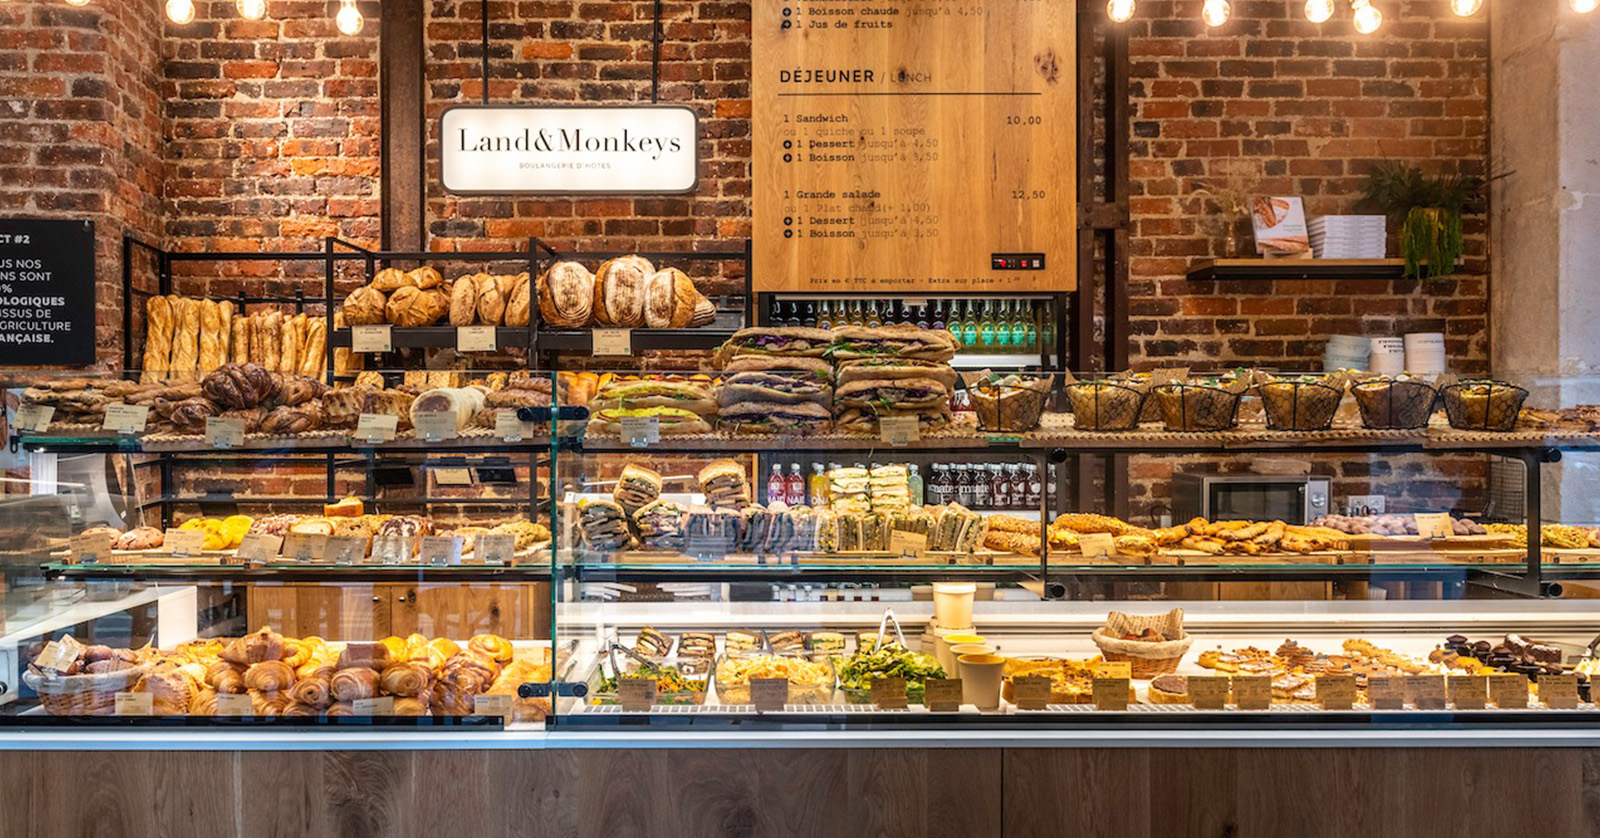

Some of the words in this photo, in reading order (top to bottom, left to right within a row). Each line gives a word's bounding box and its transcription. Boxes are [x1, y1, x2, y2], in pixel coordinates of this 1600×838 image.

[808, 7, 854, 15] Boisson
[860, 7, 899, 15] chaude
[809, 20, 828, 28] Jus
[835, 20, 847, 28] de
[854, 20, 892, 28] fruits
[780, 67, 874, 82] DÉJEUNER
[890, 72, 931, 83] LUNCH
[784, 114, 789, 123] 1
[796, 114, 848, 123] Sandwich
[816, 127, 855, 137] quiche
[860, 128, 874, 136] ou
[893, 128, 925, 138] soupe
[458, 128, 681, 160] Land&Monkeys
[809, 139, 855, 148] Dessert
[912, 138, 938, 149] 4,50
[809, 153, 855, 162] Boisson
[913, 152, 938, 163] 3,50
[784, 190, 789, 199] 1
[796, 190, 836, 199] Grande
[842, 189, 881, 199] salade
[1012, 190, 1045, 201] 12,50
[817, 203, 842, 212] Plat
[809, 216, 855, 225] Dessert
[913, 215, 939, 226] 4,50
[809, 229, 855, 238] Boisson
[14, 234, 30, 244] #2
[16, 259, 42, 269] NOS
[19, 271, 52, 281] SONT
[36, 308, 52, 319] DE
